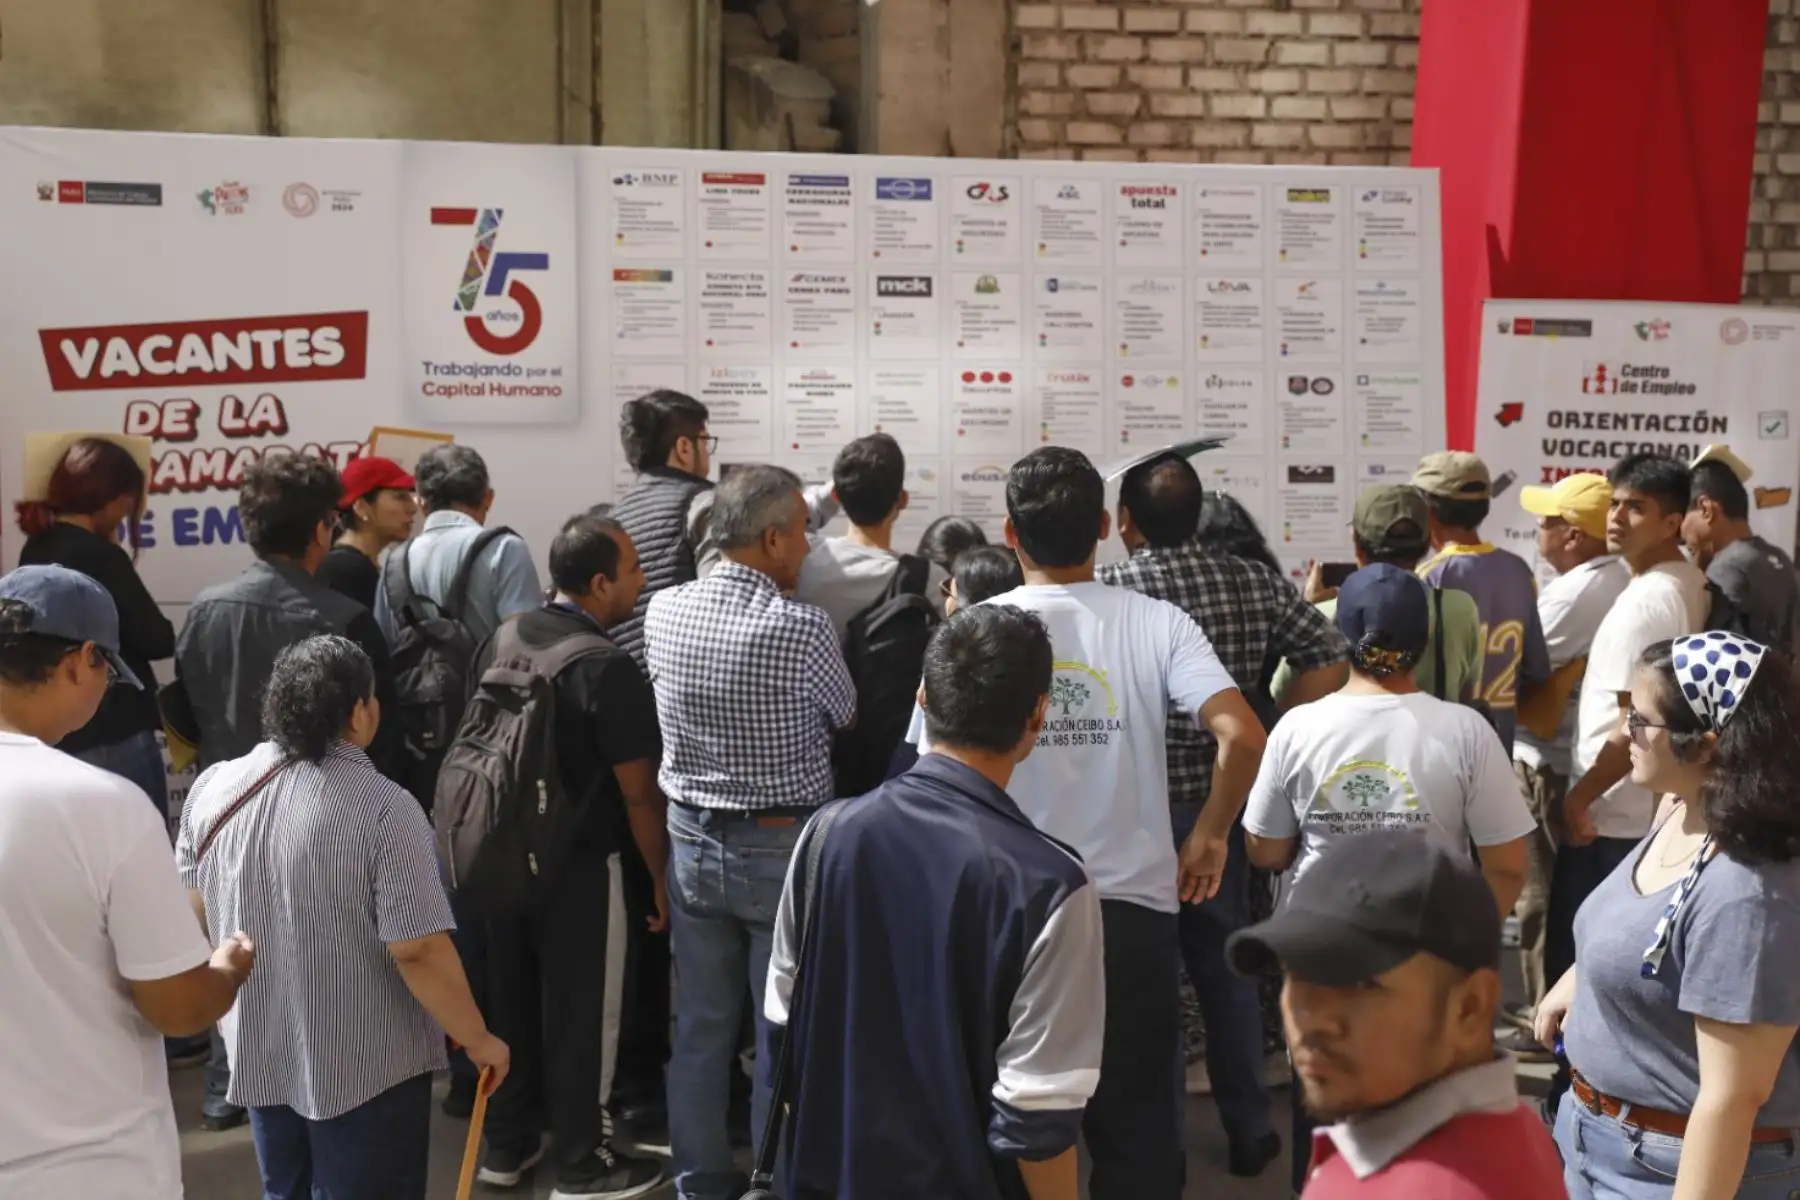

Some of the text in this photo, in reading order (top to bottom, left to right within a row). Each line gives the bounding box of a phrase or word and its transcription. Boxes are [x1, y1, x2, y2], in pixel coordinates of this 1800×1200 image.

[1120, 184, 1178, 197] apuesta
[1131, 197, 1166, 209] total
[486, 309, 520, 322] años
[60, 326, 346, 380] VACANTES
[421, 361, 563, 379] Trabajando por el
[1620, 363, 1670, 379] Centro
[421, 381, 563, 399] Capital Humano
[1619, 379, 1697, 396] de Empleo
[124, 393, 289, 442] DE LA
[1546, 409, 1729, 434] ORIENTACIÓN
[1504, 528, 1518, 539] Te
[1042, 717, 1075, 732] RACIÓN
[1077, 719, 1104, 731] CEIBO
[1053, 733, 1070, 746] 985
[1072, 733, 1088, 746] 551
[1090, 732, 1109, 745] 352
